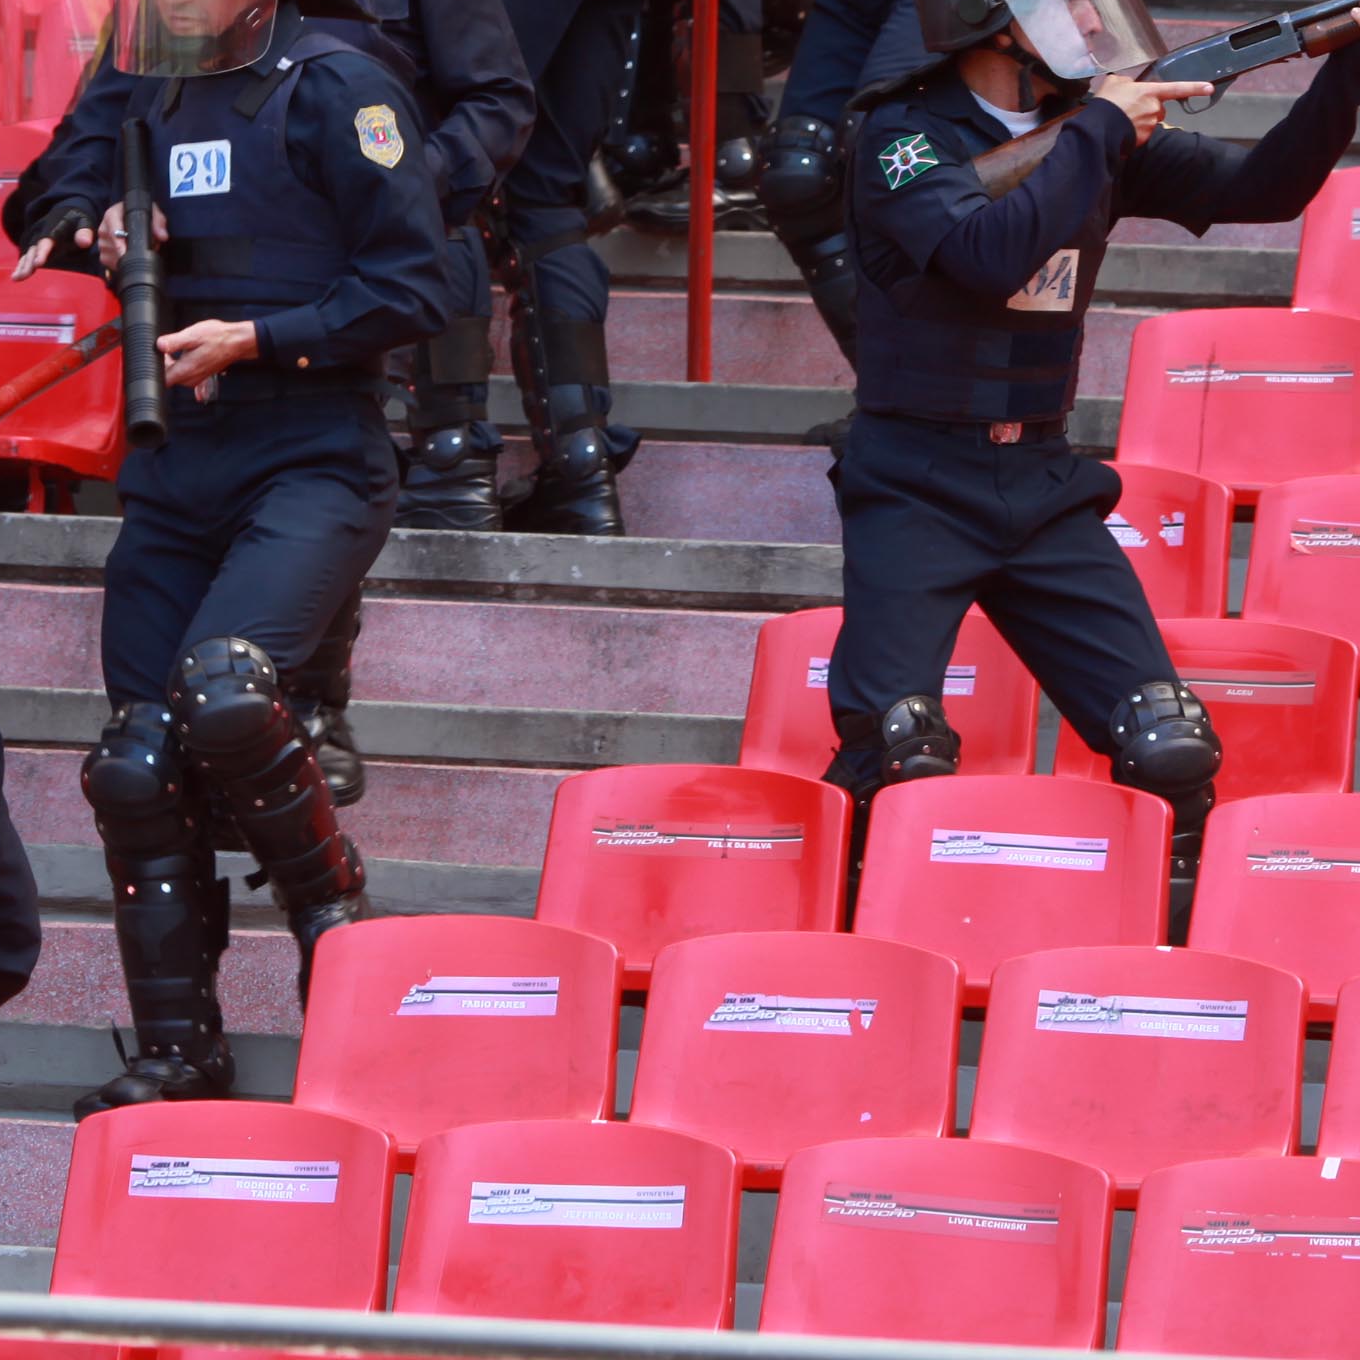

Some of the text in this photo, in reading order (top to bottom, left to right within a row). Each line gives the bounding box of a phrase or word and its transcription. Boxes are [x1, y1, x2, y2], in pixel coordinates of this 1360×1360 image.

[175, 149, 227, 194] 29
[747, 842, 773, 851] SILVA
[461, 998, 526, 1010] FABIO FARES
[1140, 1020, 1220, 1033] GABRIEL FARES
[149, 1160, 171, 1169] SOU
[235, 1179, 284, 1190] RODRIGO
[250, 1189, 293, 1200] TANNER
[562, 1208, 624, 1221] JEFFERSON
[827, 1206, 916, 1218] FURACÃO
[947, 1216, 1027, 1231] LIVIA LECHINSKI
[1185, 1233, 1276, 1245] FURACÃO
[1308, 1237, 1351, 1247] IVERSON
